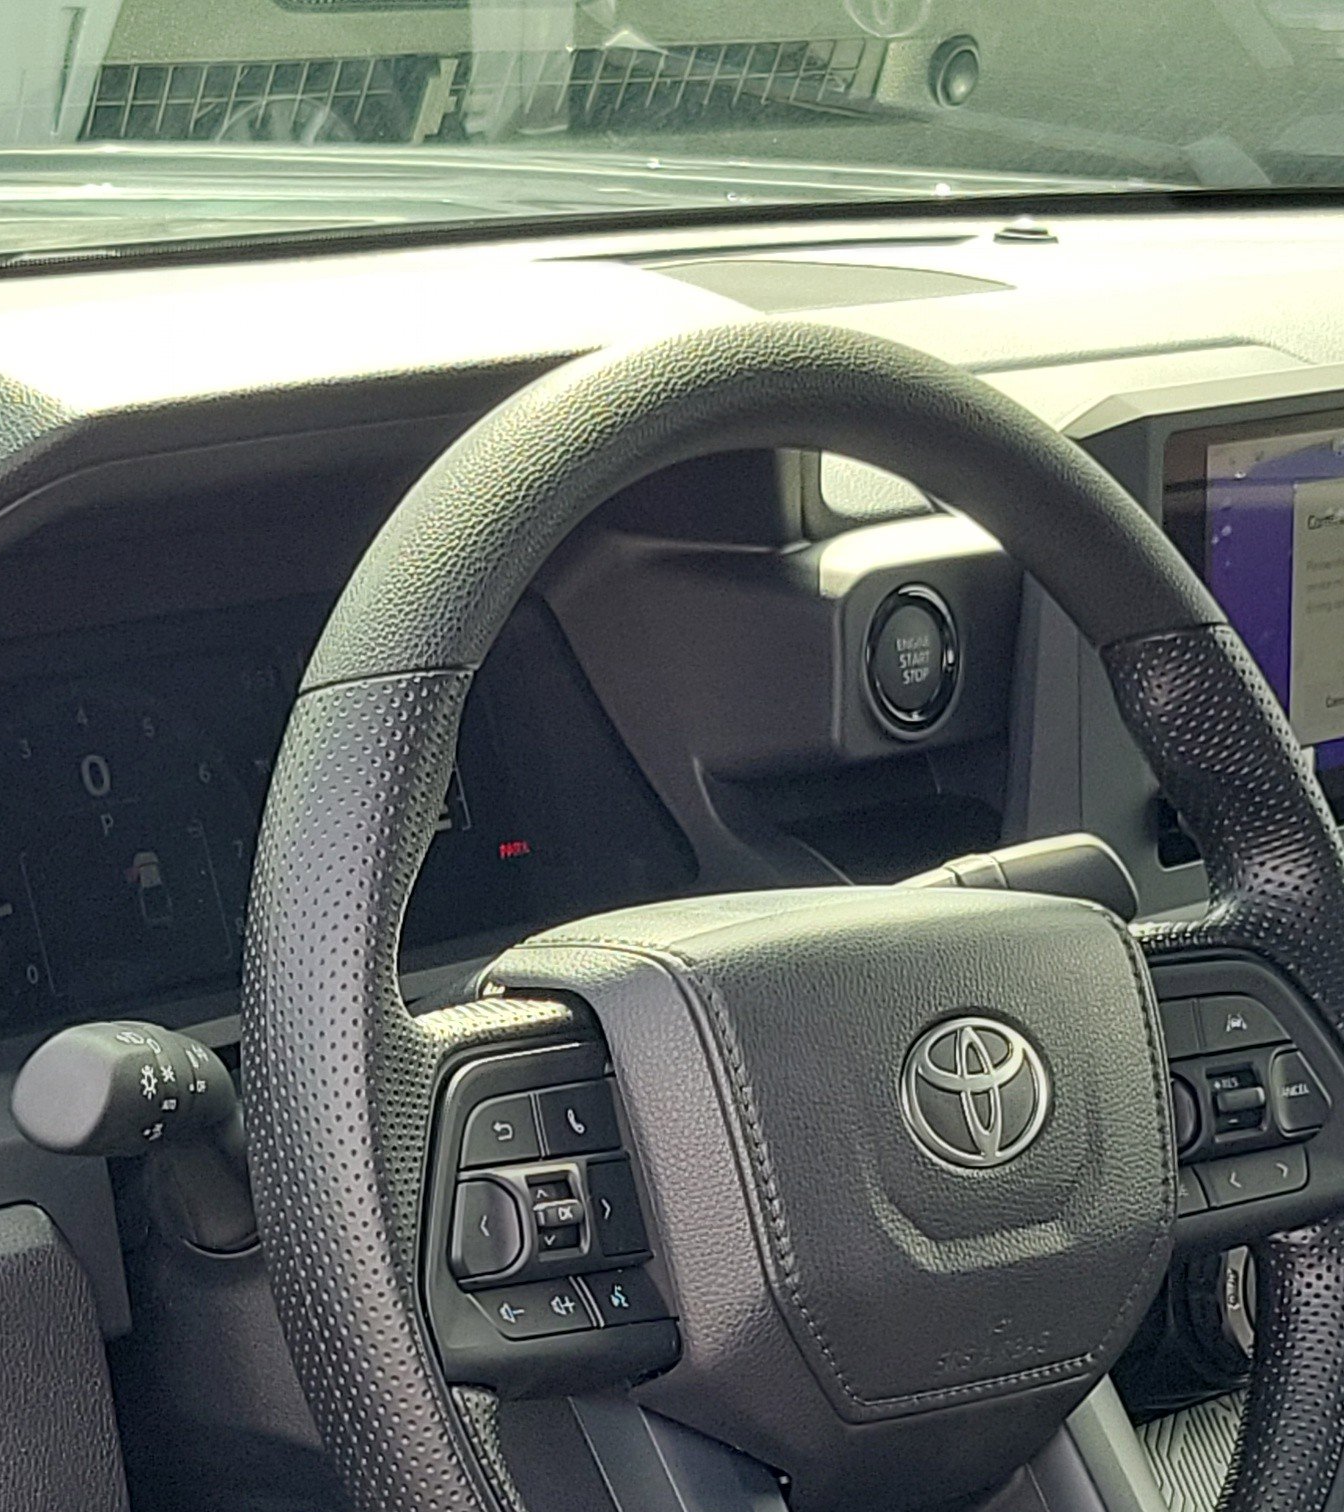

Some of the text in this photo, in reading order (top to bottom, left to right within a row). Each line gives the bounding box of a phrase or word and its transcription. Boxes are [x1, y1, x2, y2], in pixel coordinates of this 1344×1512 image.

[899, 651, 930, 668] START
[903, 668, 929, 685] STOP
[80, 754, 111, 797] 0
